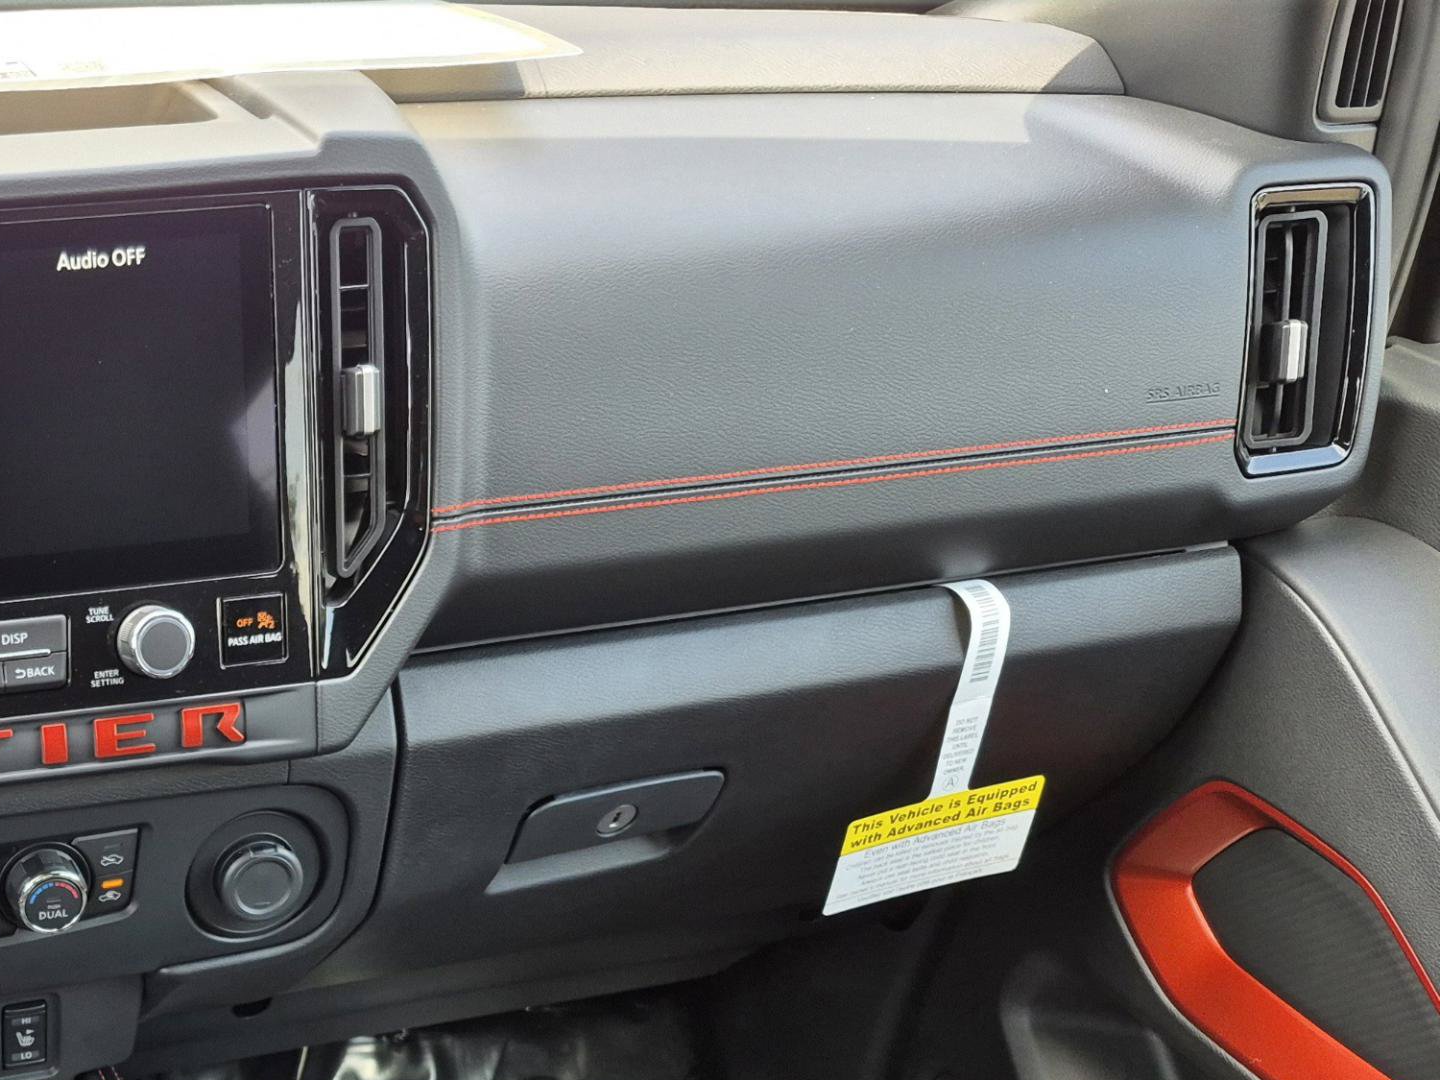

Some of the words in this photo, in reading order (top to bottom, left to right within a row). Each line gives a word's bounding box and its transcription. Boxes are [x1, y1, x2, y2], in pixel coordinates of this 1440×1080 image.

[57, 250, 109, 272] Audio
[111, 246, 146, 267] OFF
[89, 606, 109, 617] TUNE
[85, 613, 115, 624] SCROLL
[236, 617, 254, 628] OFF
[1, 632, 28, 646] DISP
[228, 635, 248, 647] PASS
[249, 633, 264, 645] AIR
[264, 631, 283, 643] BAG
[26, 665, 55, 678] BACK
[94, 669, 120, 680] ENTER
[90, 676, 125, 689] SETTING
[852, 820, 883, 835] This
[889, 802, 944, 824] Vehicle
[948, 798, 961, 809] is
[966, 781, 1038, 805] Equipped
[850, 832, 882, 849] with
[886, 810, 961, 838] Advanced
[965, 805, 988, 819] Air
[992, 798, 1030, 813] Bags
[913, 828, 962, 846] Advanced
[39, 908, 68, 922] DUAL
[21, 1017, 32, 1025] HI
[20, 1051, 33, 1060] LO
